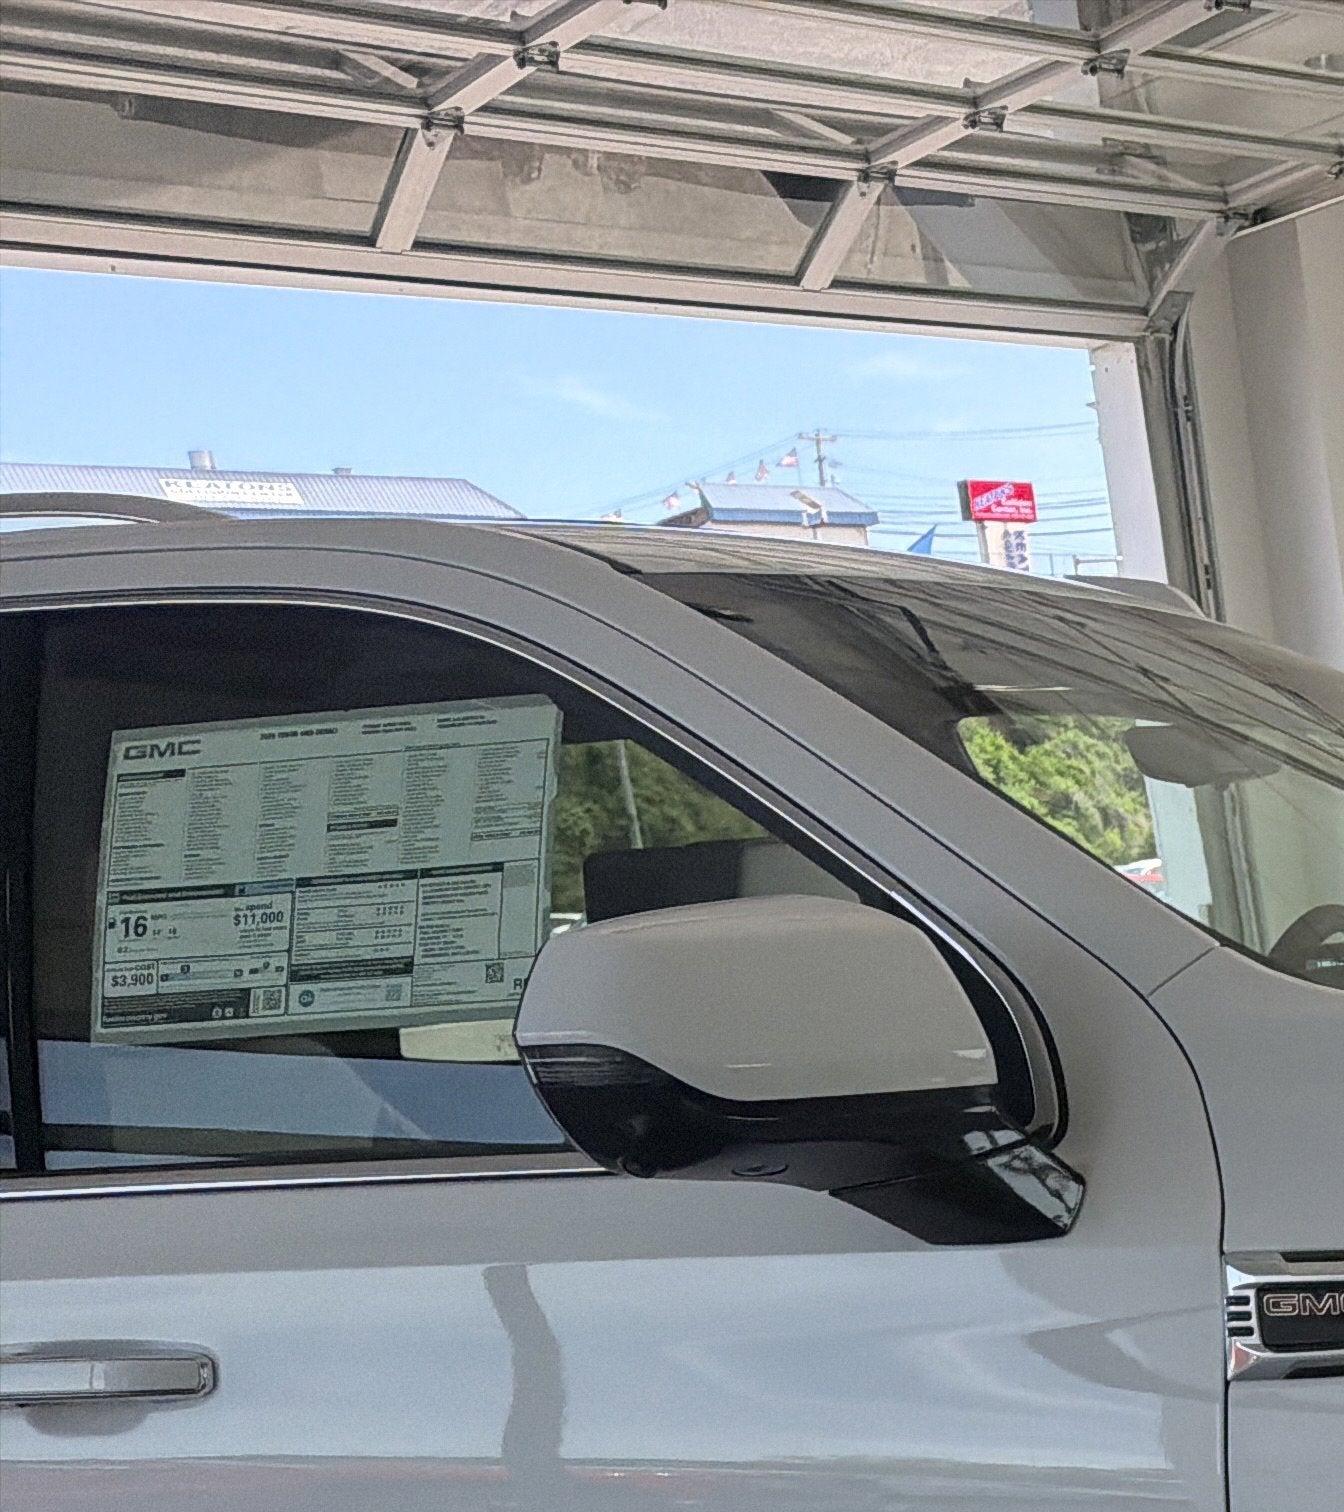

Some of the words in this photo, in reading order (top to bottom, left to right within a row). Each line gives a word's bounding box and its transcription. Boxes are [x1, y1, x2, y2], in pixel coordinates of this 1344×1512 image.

[123, 739, 202, 760] GMC
[120, 915, 148, 938] 16
[233, 910, 284, 927] $11,000
[111, 973, 154, 988] $3,900
